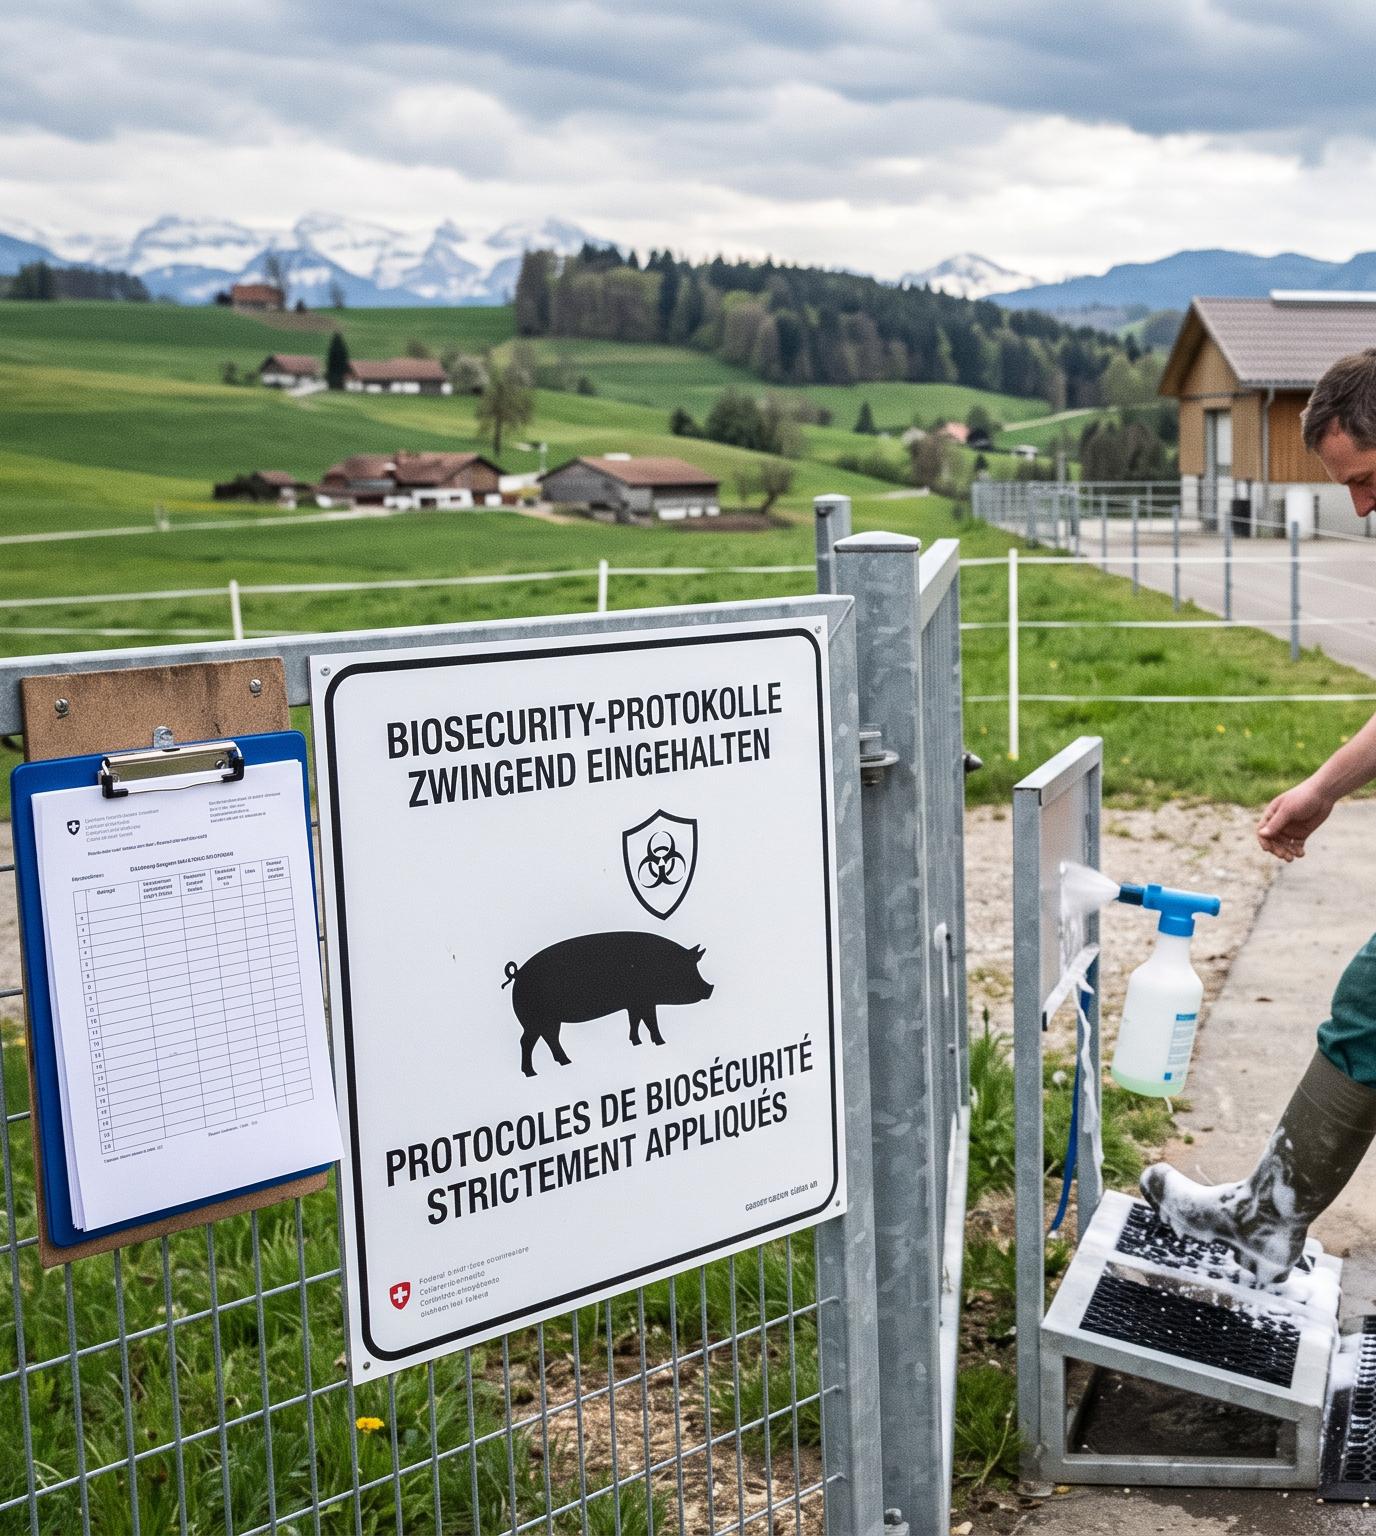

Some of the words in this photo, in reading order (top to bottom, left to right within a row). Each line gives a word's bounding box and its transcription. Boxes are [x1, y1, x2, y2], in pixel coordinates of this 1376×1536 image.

[387, 682, 782, 760] BIOSECURITY-PROTOKOLLE
[409, 752, 576, 808] ZWINGEND
[588, 728, 770, 784] EINGEHALTEN
[386, 1101, 591, 1188] PROTOCOLES
[601, 1088, 637, 1128] DE
[646, 1034, 813, 1115] BIOSÉCURITÉ
[428, 1134, 637, 1225] STRICTEMENT
[646, 1090, 788, 1162] APPLIQUÉS
